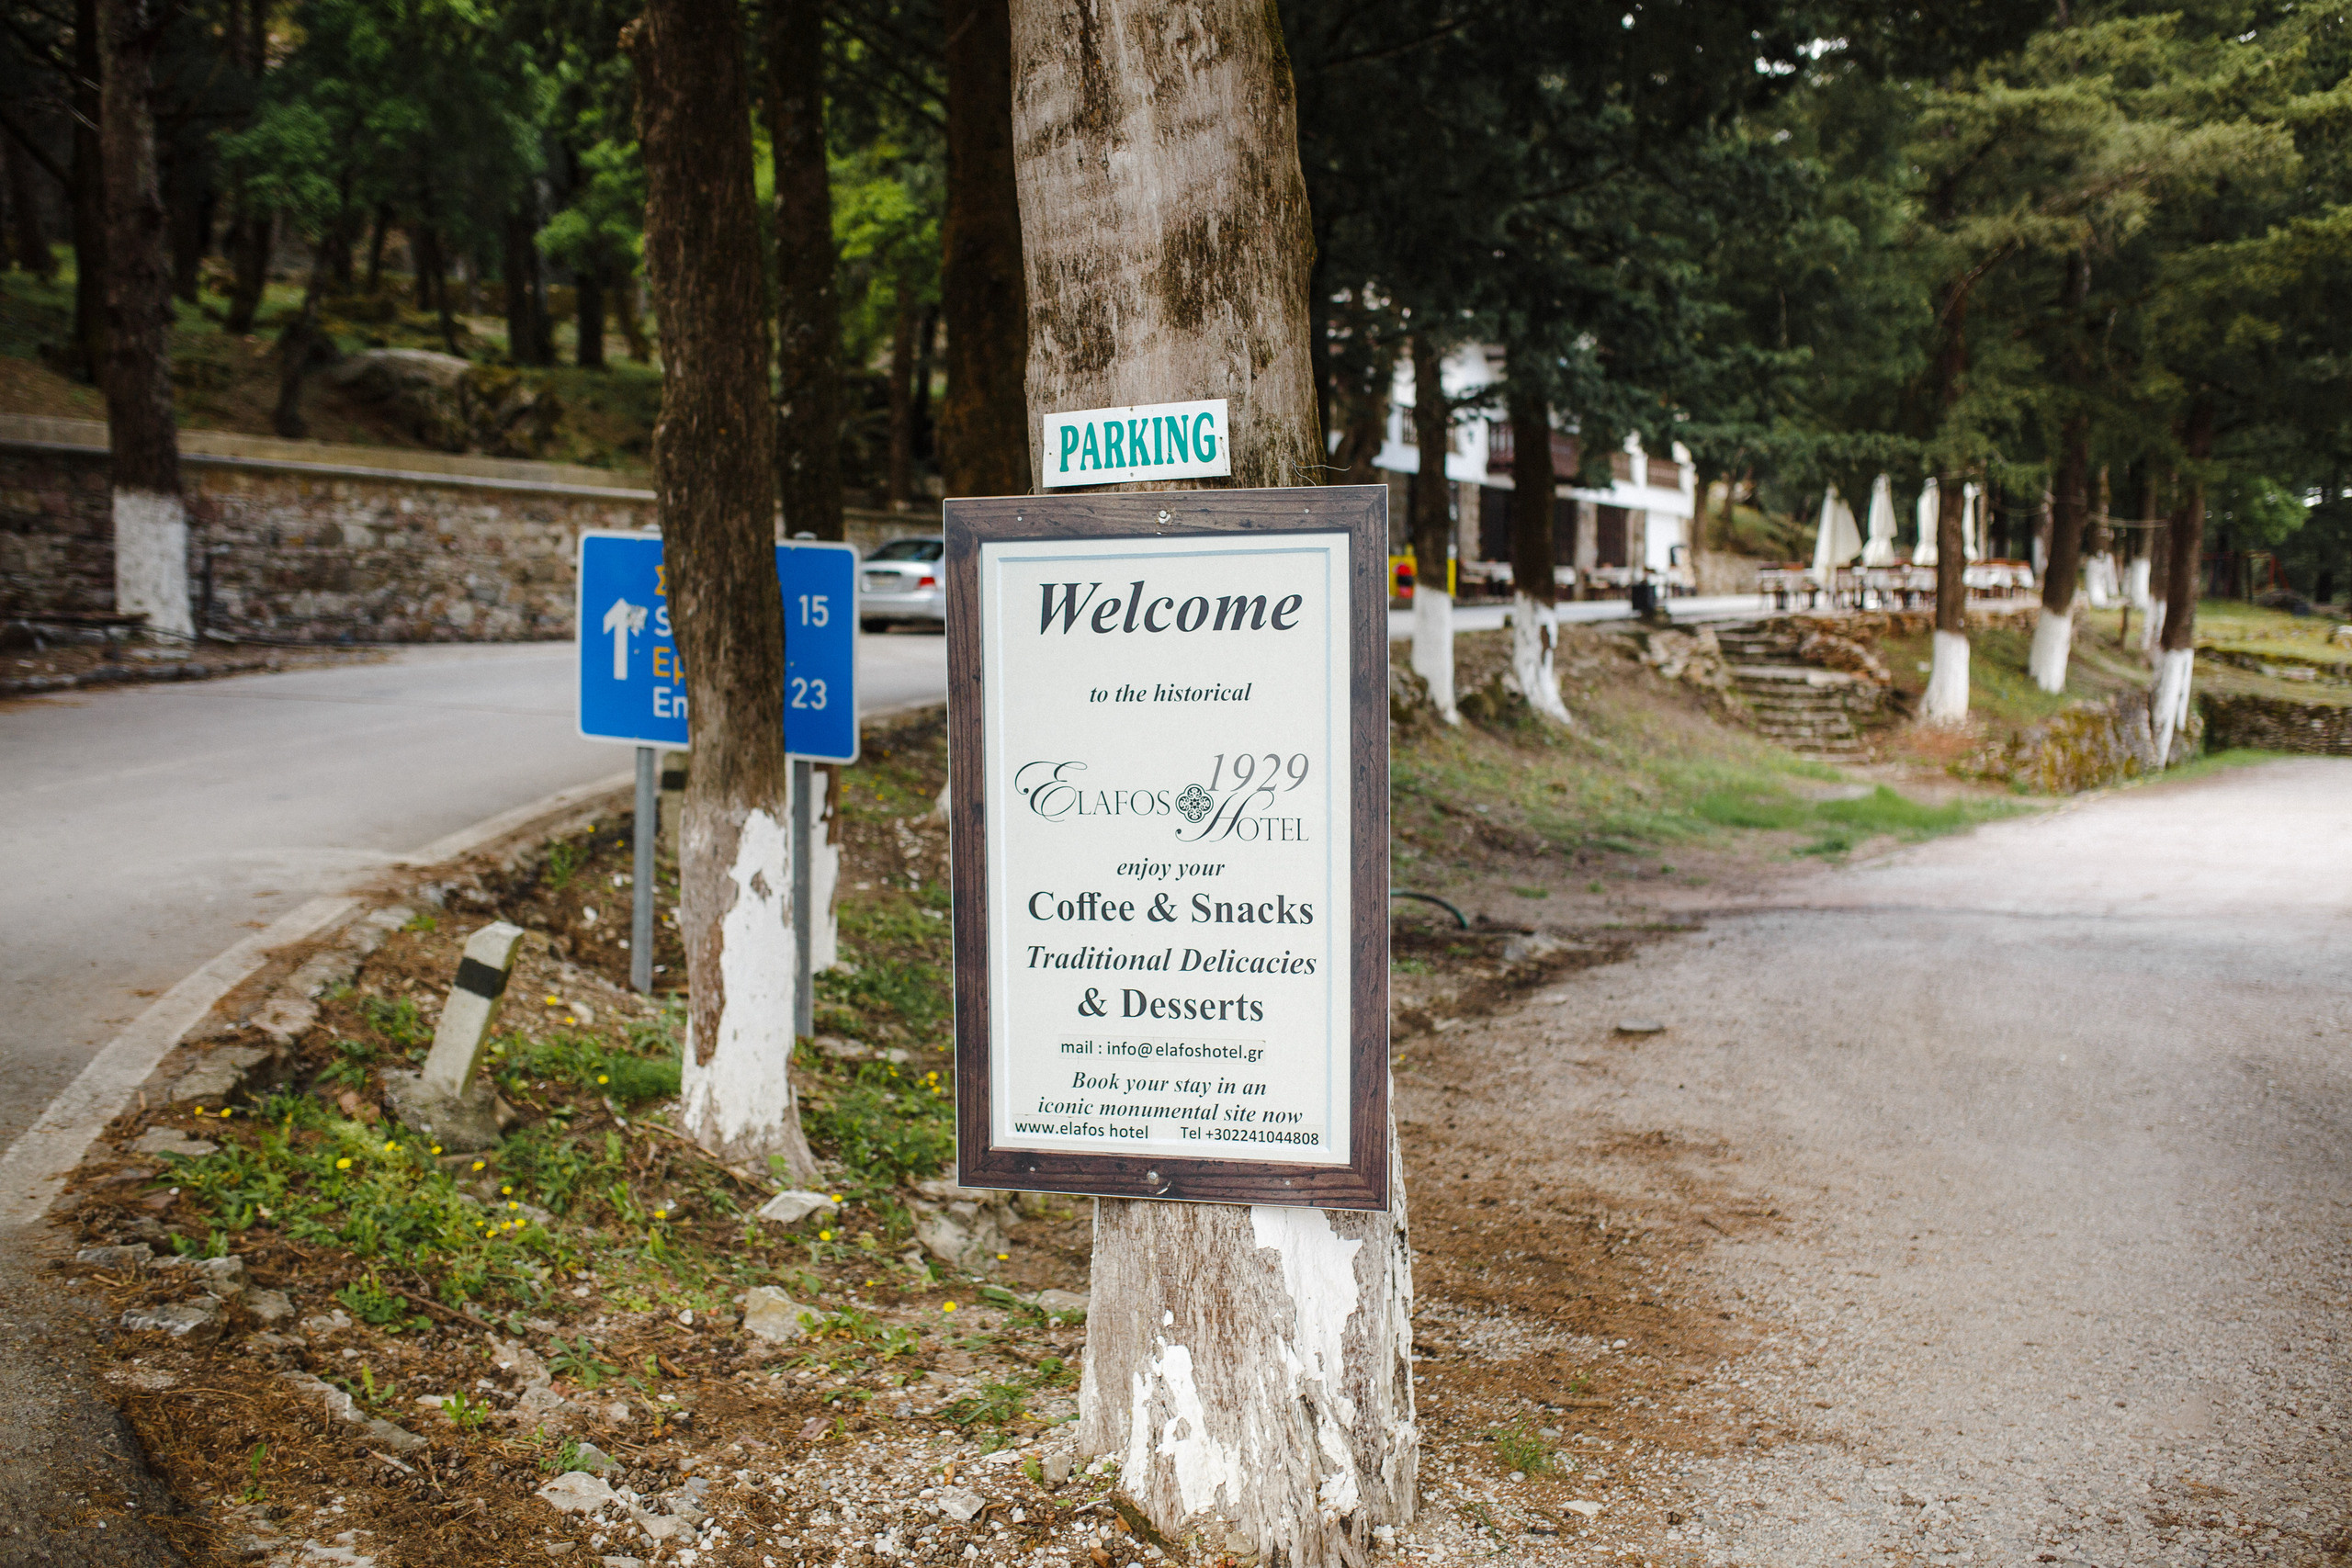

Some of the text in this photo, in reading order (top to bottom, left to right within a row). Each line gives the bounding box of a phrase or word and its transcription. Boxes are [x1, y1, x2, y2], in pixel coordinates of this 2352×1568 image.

[1059, 412, 1217, 472] PARKING
[798, 594, 830, 627] 15
[1039, 581, 1303, 635] Welcome
[790, 678, 828, 711] 23
[1090, 682, 1252, 703] to the historical
[1206, 753, 1309, 793] 1929
[1116, 858, 1225, 881] enjoy your
[1028, 891, 1314, 925] Coffee & Snacks
[1027, 946, 1317, 976] Traditional Delicacies
[1078, 987, 1264, 1022] & Desserts
[1061, 1041, 1092, 1055] mail
[1071, 1071, 1267, 1098] Book your stay in an
[1038, 1097, 1303, 1124] iconic monumental site now
[1015, 1122, 1148, 1140] www.elafos hotel
[1181, 1126, 1319, 1145] Tel +302241044808
